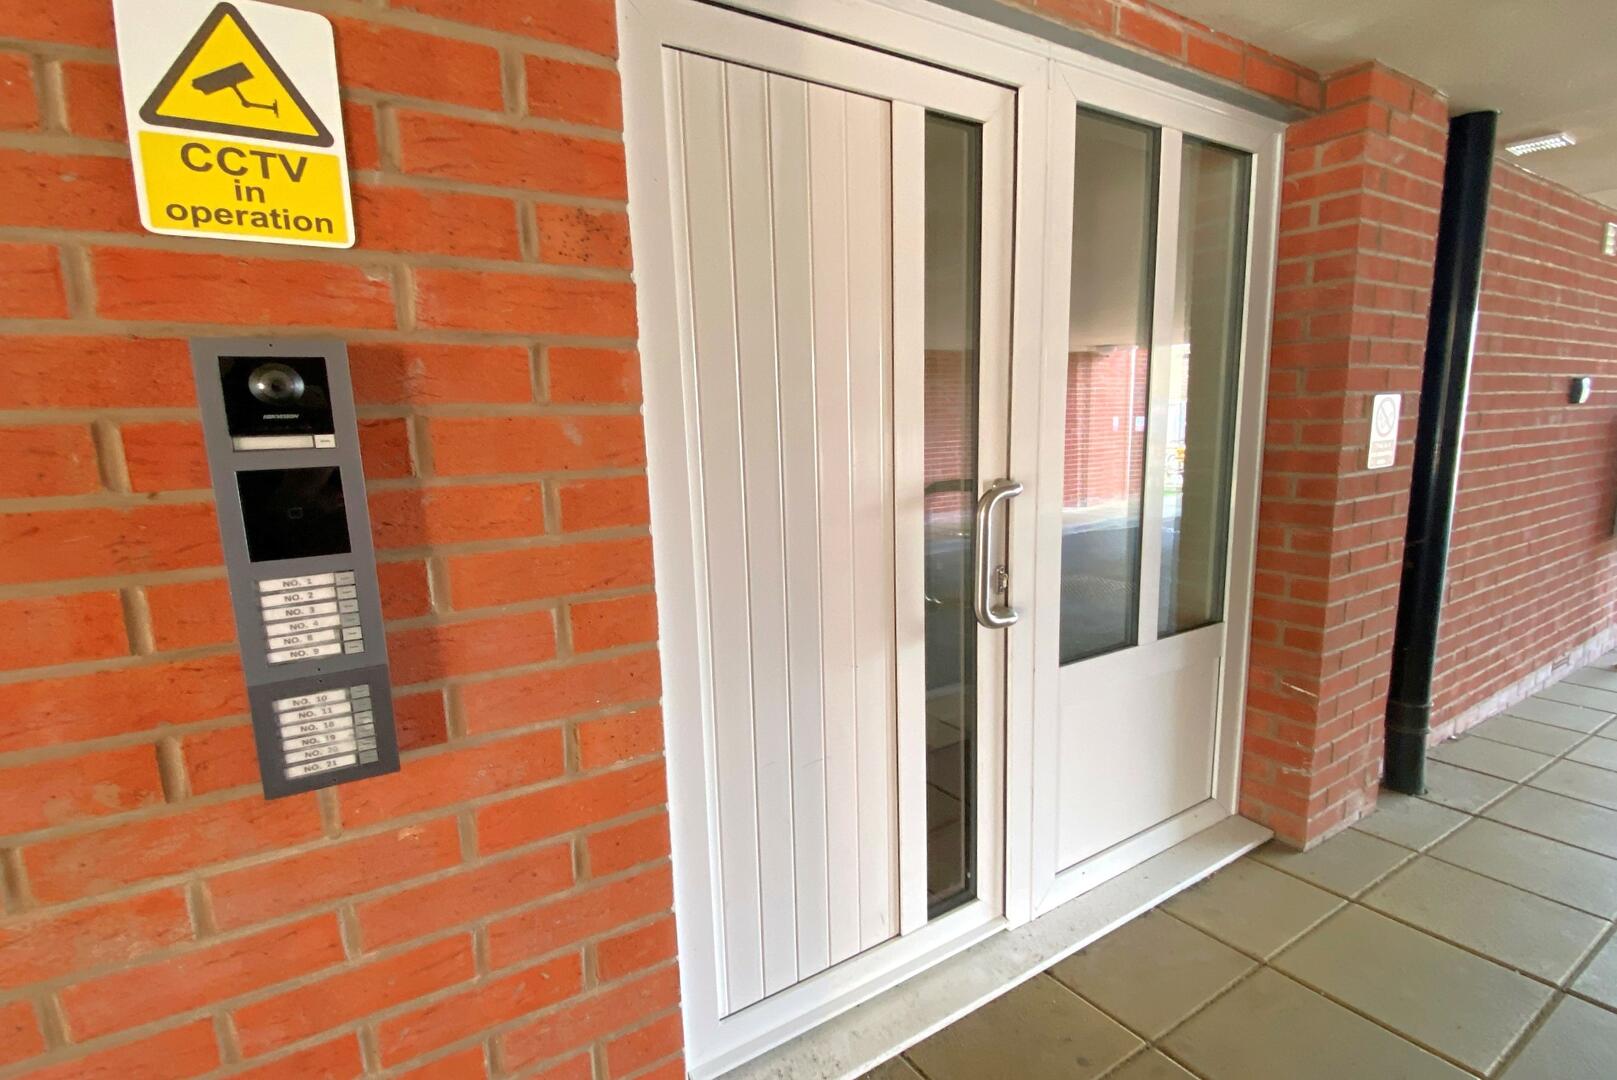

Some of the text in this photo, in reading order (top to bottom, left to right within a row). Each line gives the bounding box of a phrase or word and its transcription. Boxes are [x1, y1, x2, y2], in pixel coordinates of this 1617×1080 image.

[180, 142, 308, 183] CCTV
[234, 179, 265, 203] in
[166, 203, 334, 235] operation
[282, 579, 302, 588] NO.
[283, 593, 303, 602] NO.
[285, 608, 304, 617] NO.
[289, 622, 308, 631] NO.
[283, 636, 302, 645] NO.
[289, 650, 308, 658] NO.
[292, 698, 311, 706] NO.
[298, 710, 317, 719] NO.
[300, 724, 319, 733] NO.
[301, 737, 320, 746] NO.
[304, 749, 323, 758] NO.
[303, 764, 322, 773] NO.
